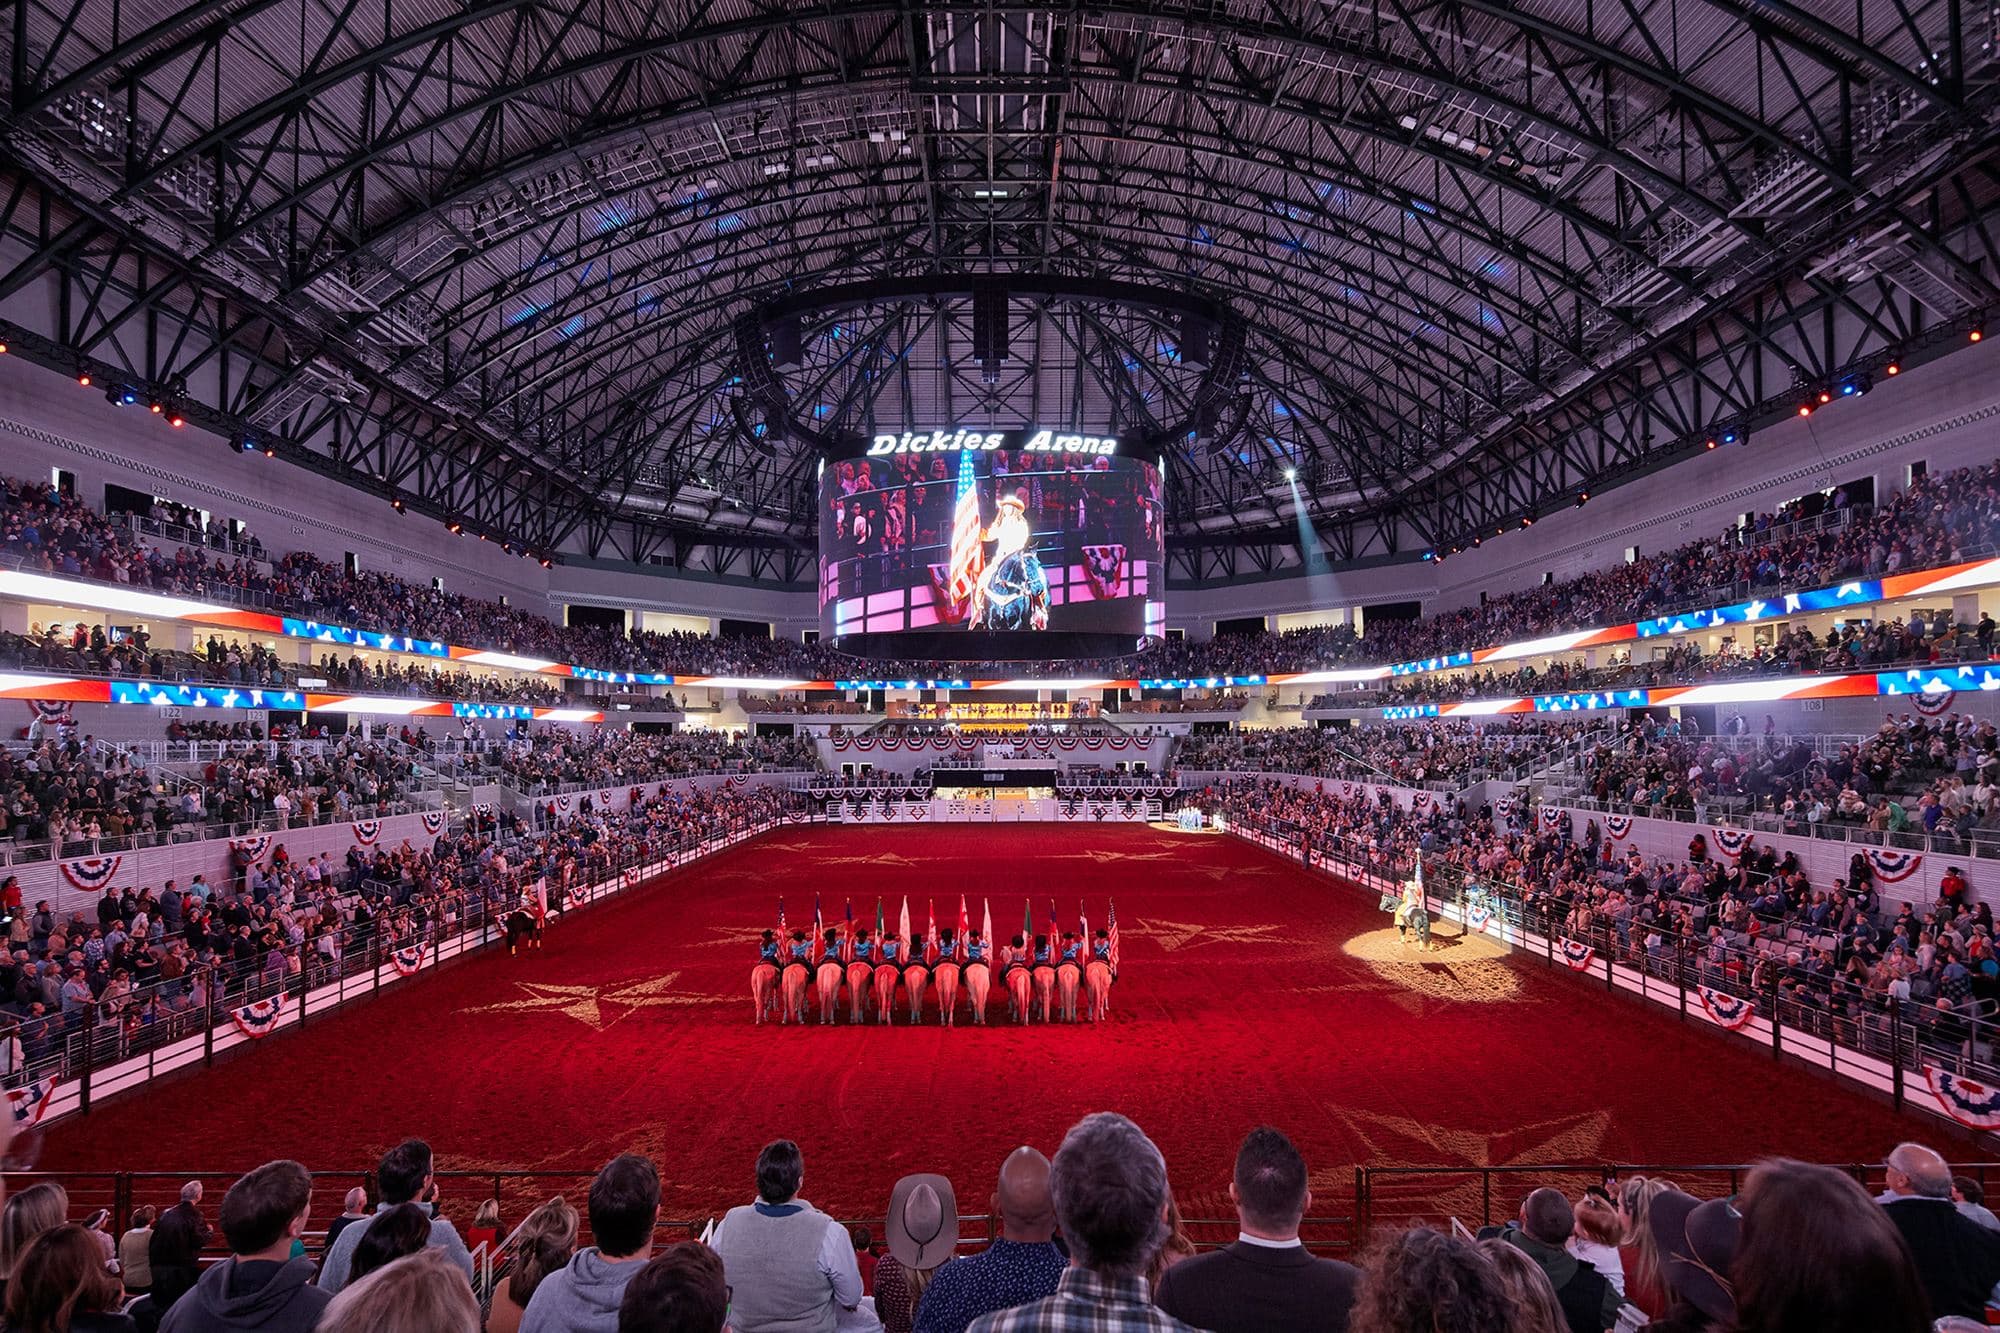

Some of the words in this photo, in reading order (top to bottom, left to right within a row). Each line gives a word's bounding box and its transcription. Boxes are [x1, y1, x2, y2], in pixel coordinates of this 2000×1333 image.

[866, 430, 1005, 456] Dickies
[1024, 431, 1118, 455] Arena
[153, 484, 168, 495] 223
[1804, 700, 1821, 711] 108
[163, 707, 181, 717] 122
[250, 710, 264, 720] 123
